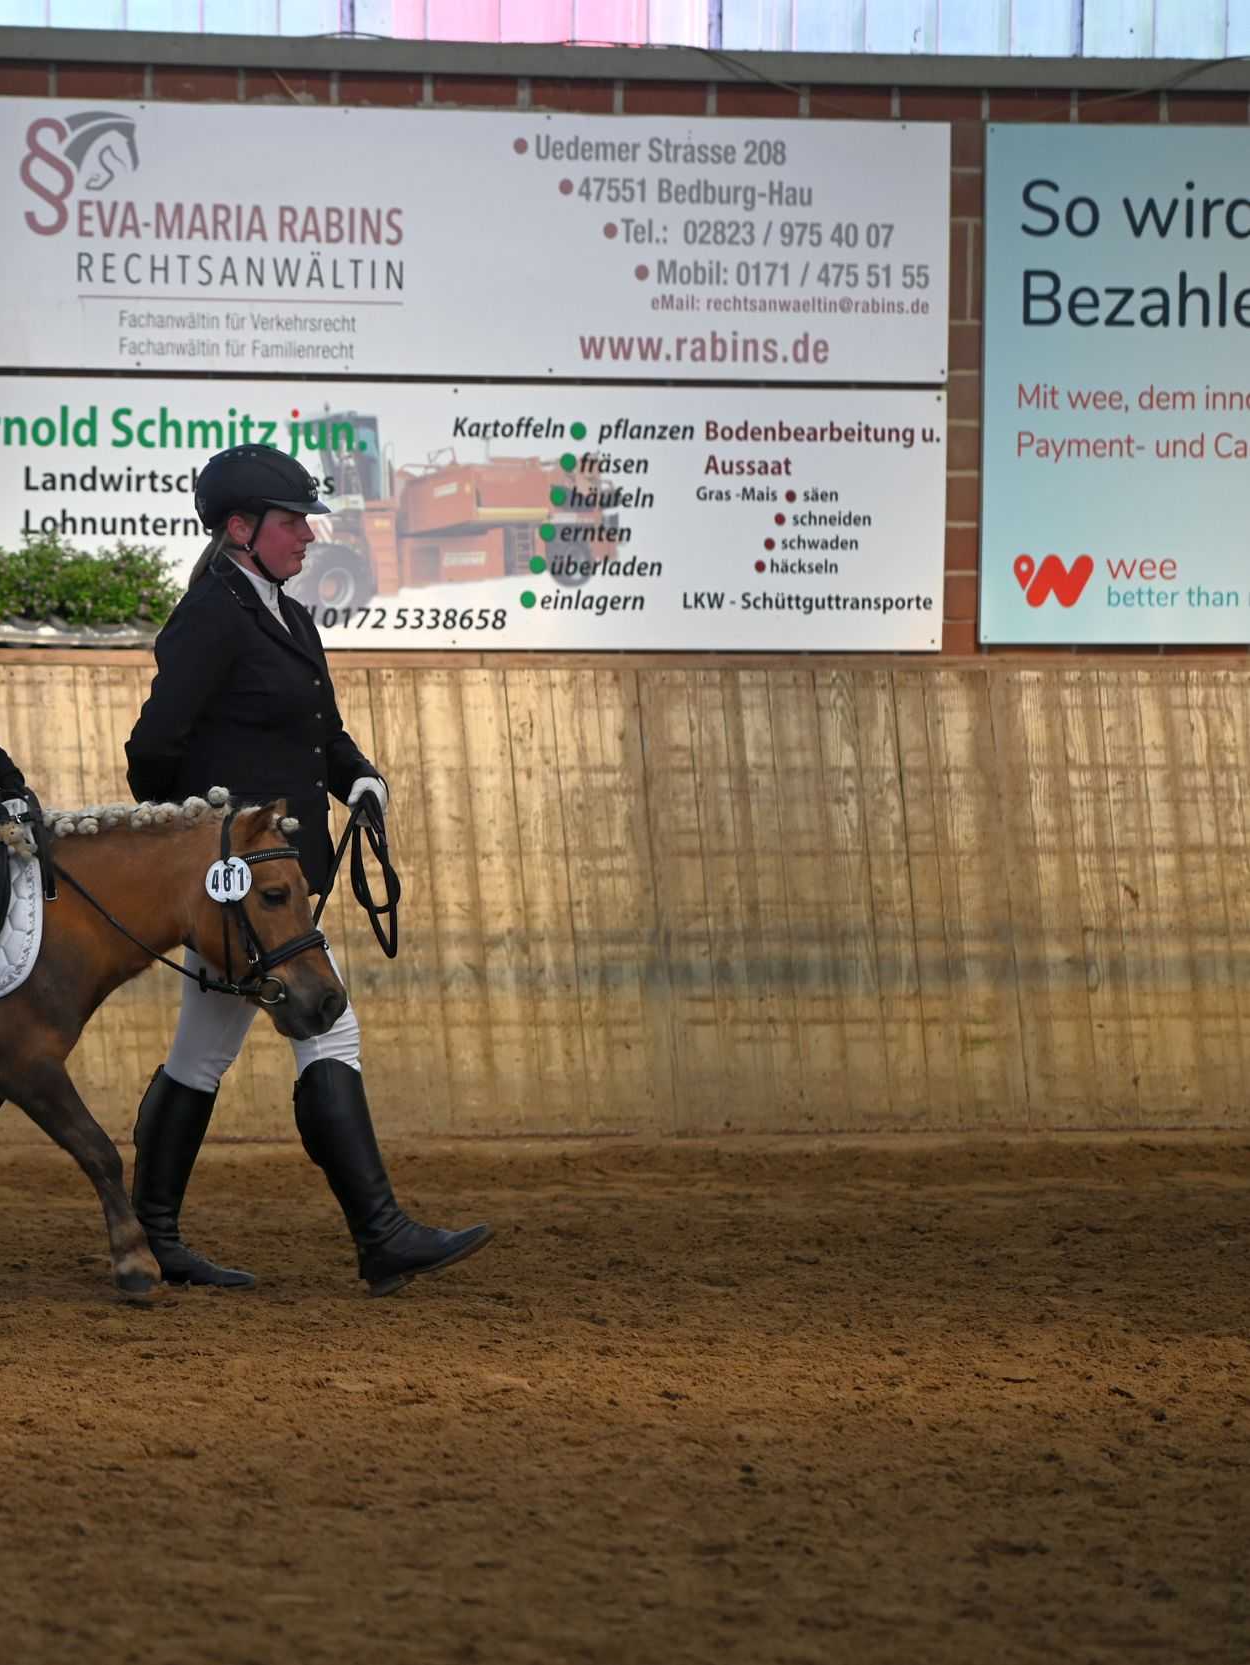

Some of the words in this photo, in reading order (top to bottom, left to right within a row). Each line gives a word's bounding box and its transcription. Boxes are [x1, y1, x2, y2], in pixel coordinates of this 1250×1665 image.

[535, 134, 640, 162] Uedemer
[647, 137, 736, 165] Strasse
[743, 140, 786, 166] 208
[578, 177, 647, 203] 47551
[657, 178, 813, 211] Bedburg-Hau
[1020, 178, 1100, 239] So
[77, 200, 267, 242] EVA-MARIA
[278, 206, 403, 245] RABINS
[621, 218, 668, 245] Tel.:
[683, 220, 755, 246] 02823
[780, 222, 822, 247] 975
[830, 223, 859, 248] 40
[866, 224, 894, 248] 07
[77, 251, 404, 290] RECHTSANWÄLTIN
[657, 259, 728, 287] Mobil:
[736, 261, 790, 288] 0171
[817, 264, 859, 289] 475
[867, 265, 893, 289] 51
[902, 265, 929, 289] 55
[651, 295, 700, 312] eMail:
[706, 296, 929, 315] rechtsanwaeltin@rabins.de
[119, 310, 219, 330] Fachanwältin
[225, 313, 247, 331] für
[250, 313, 356, 333] Verkehrsrecht
[118, 337, 219, 357] Fachanwältin
[225, 339, 247, 358] für
[251, 340, 354, 360] Familienrecht
[580, 331, 829, 363] www.rabins.de
[1017, 384, 1059, 410] Mit
[1067, 390, 1129, 414] wee,
[1138, 385, 1196, 411] dem
[111, 406, 277, 449] Schmitz
[289, 409, 367, 459] jun.
[452, 417, 565, 440] Kartoffeln
[598, 421, 695, 444] pflanzen
[705, 421, 915, 448] Bodenbearbeitung
[922, 425, 941, 443] u.
[1016, 432, 1145, 466] Payment-
[1155, 431, 1205, 459] und
[579, 452, 649, 479] fräsen
[704, 455, 792, 477] Aussaat
[569, 486, 655, 510] häufeln
[696, 486, 734, 502] Gras
[803, 488, 839, 503] säen
[792, 511, 872, 527] schneiden
[560, 524, 632, 543] ernten
[781, 535, 859, 551] schwaden
[551, 552, 662, 578] überladen
[770, 559, 839, 575] häckseln
[1106, 558, 1177, 580] wee
[540, 591, 646, 617] einlagern
[682, 592, 724, 609] LKW
[742, 593, 933, 612] Schüttguttransporte
[1107, 585, 1179, 607] better
[1186, 584, 1239, 607] than
[322, 608, 386, 629] 0172
[393, 608, 507, 630] 5338658
[211, 866, 245, 893] 481
